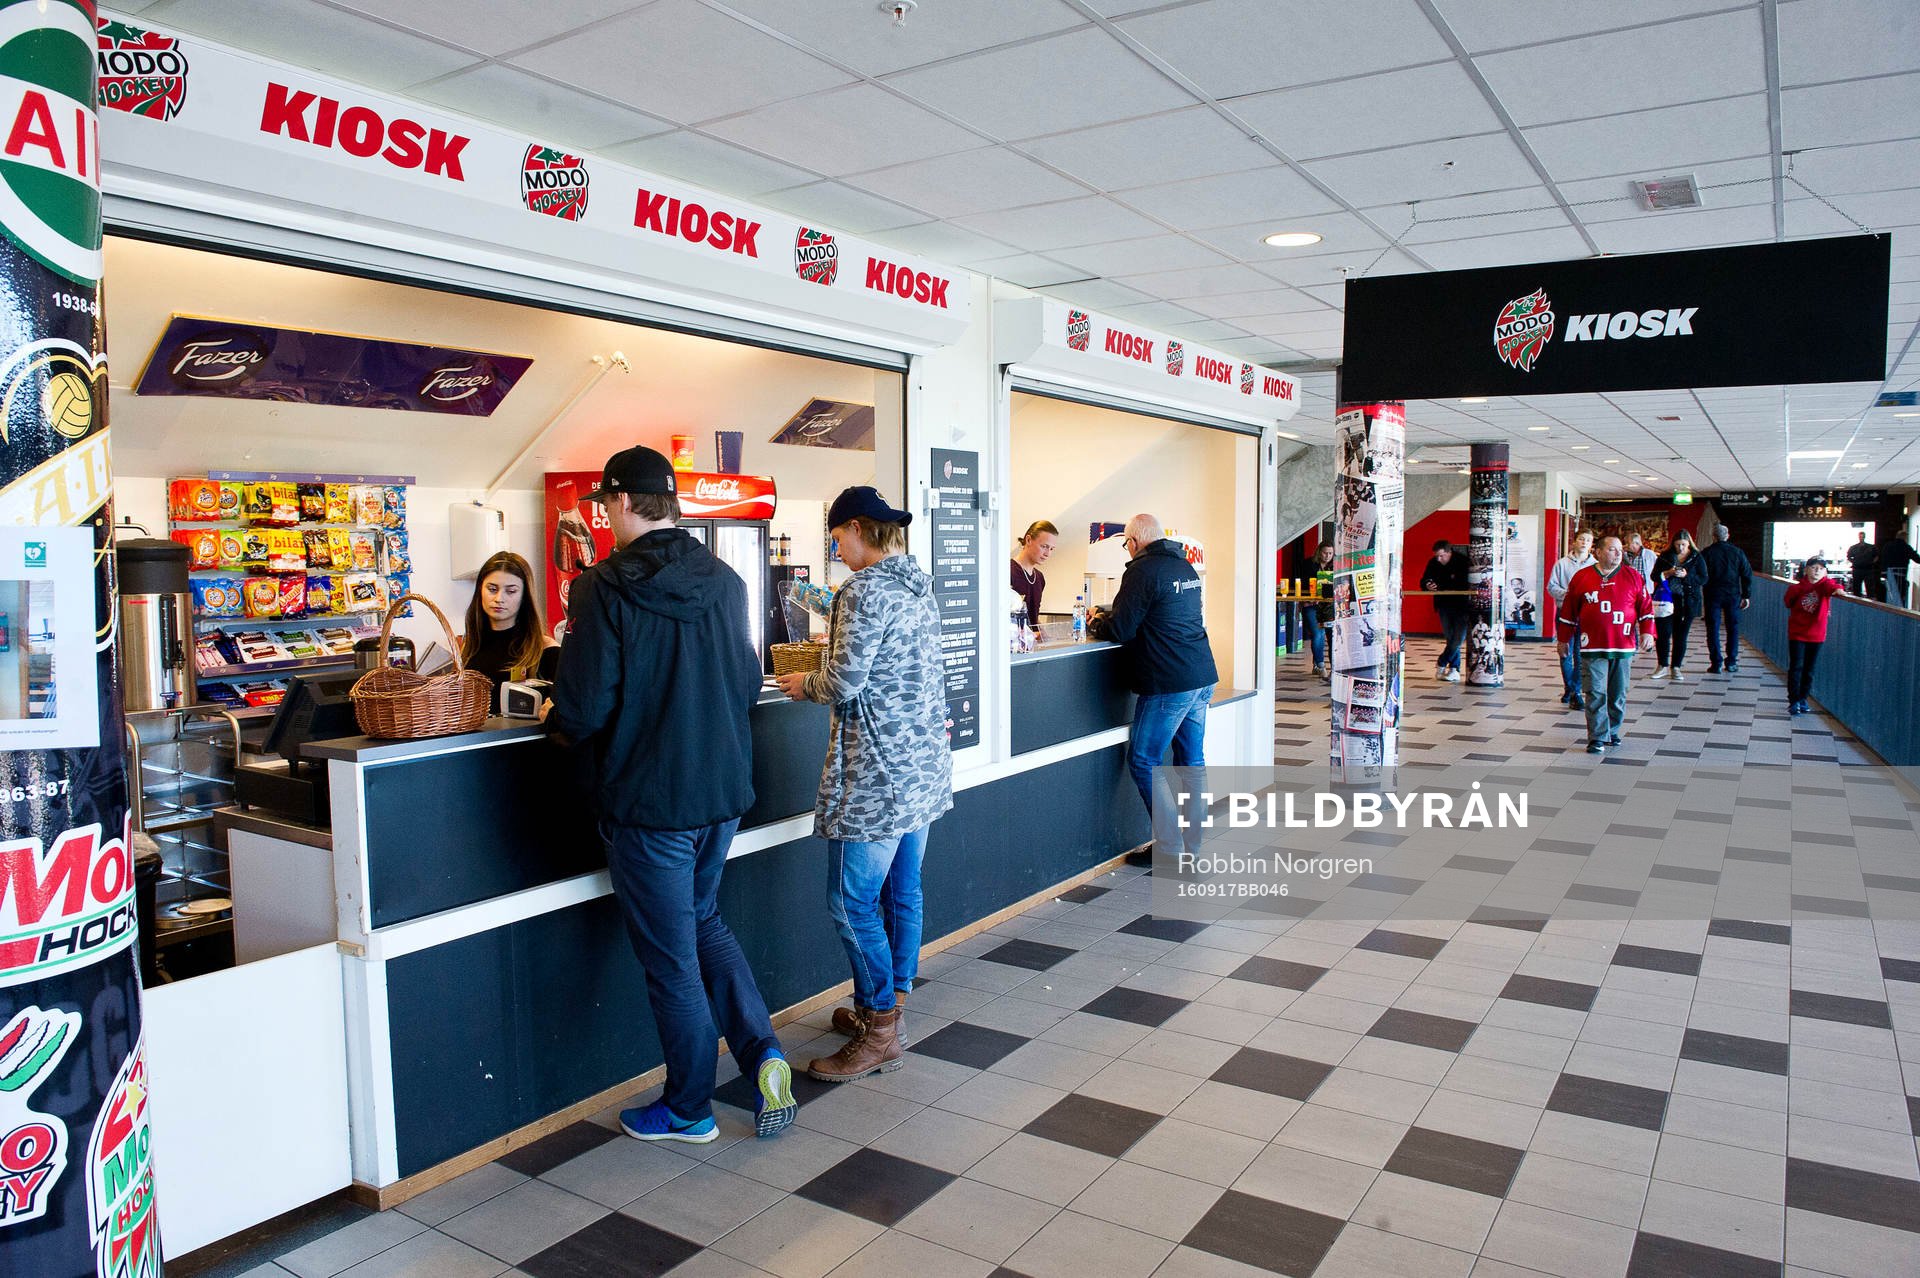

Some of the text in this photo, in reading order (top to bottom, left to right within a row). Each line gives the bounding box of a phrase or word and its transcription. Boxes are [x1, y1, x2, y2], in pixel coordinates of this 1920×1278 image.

[260, 81, 471, 182] KIOSK
[525, 168, 585, 190] MODO
[532, 188, 582, 213] HOCKEY
[633, 188, 762, 259] KIOSK
[797, 242, 835, 264] MODO
[865, 257, 950, 309] KIOSK
[1068, 319, 1090, 337] MODO
[1496, 312, 1553, 339] MODO
[1564, 307, 1700, 342] KIOSK
[1105, 328, 1154, 363] KIOSK
[1502, 325, 1549, 356] HOCKEY
[172, 338, 263, 376] Fazer
[1195, 356, 1232, 385] KIOSK
[420, 365, 493, 396] Fazer
[1263, 375, 1293, 401] KIOSK
[1797, 506, 1843, 515] ASPEN
[1584, 590, 1632, 636] MODO
